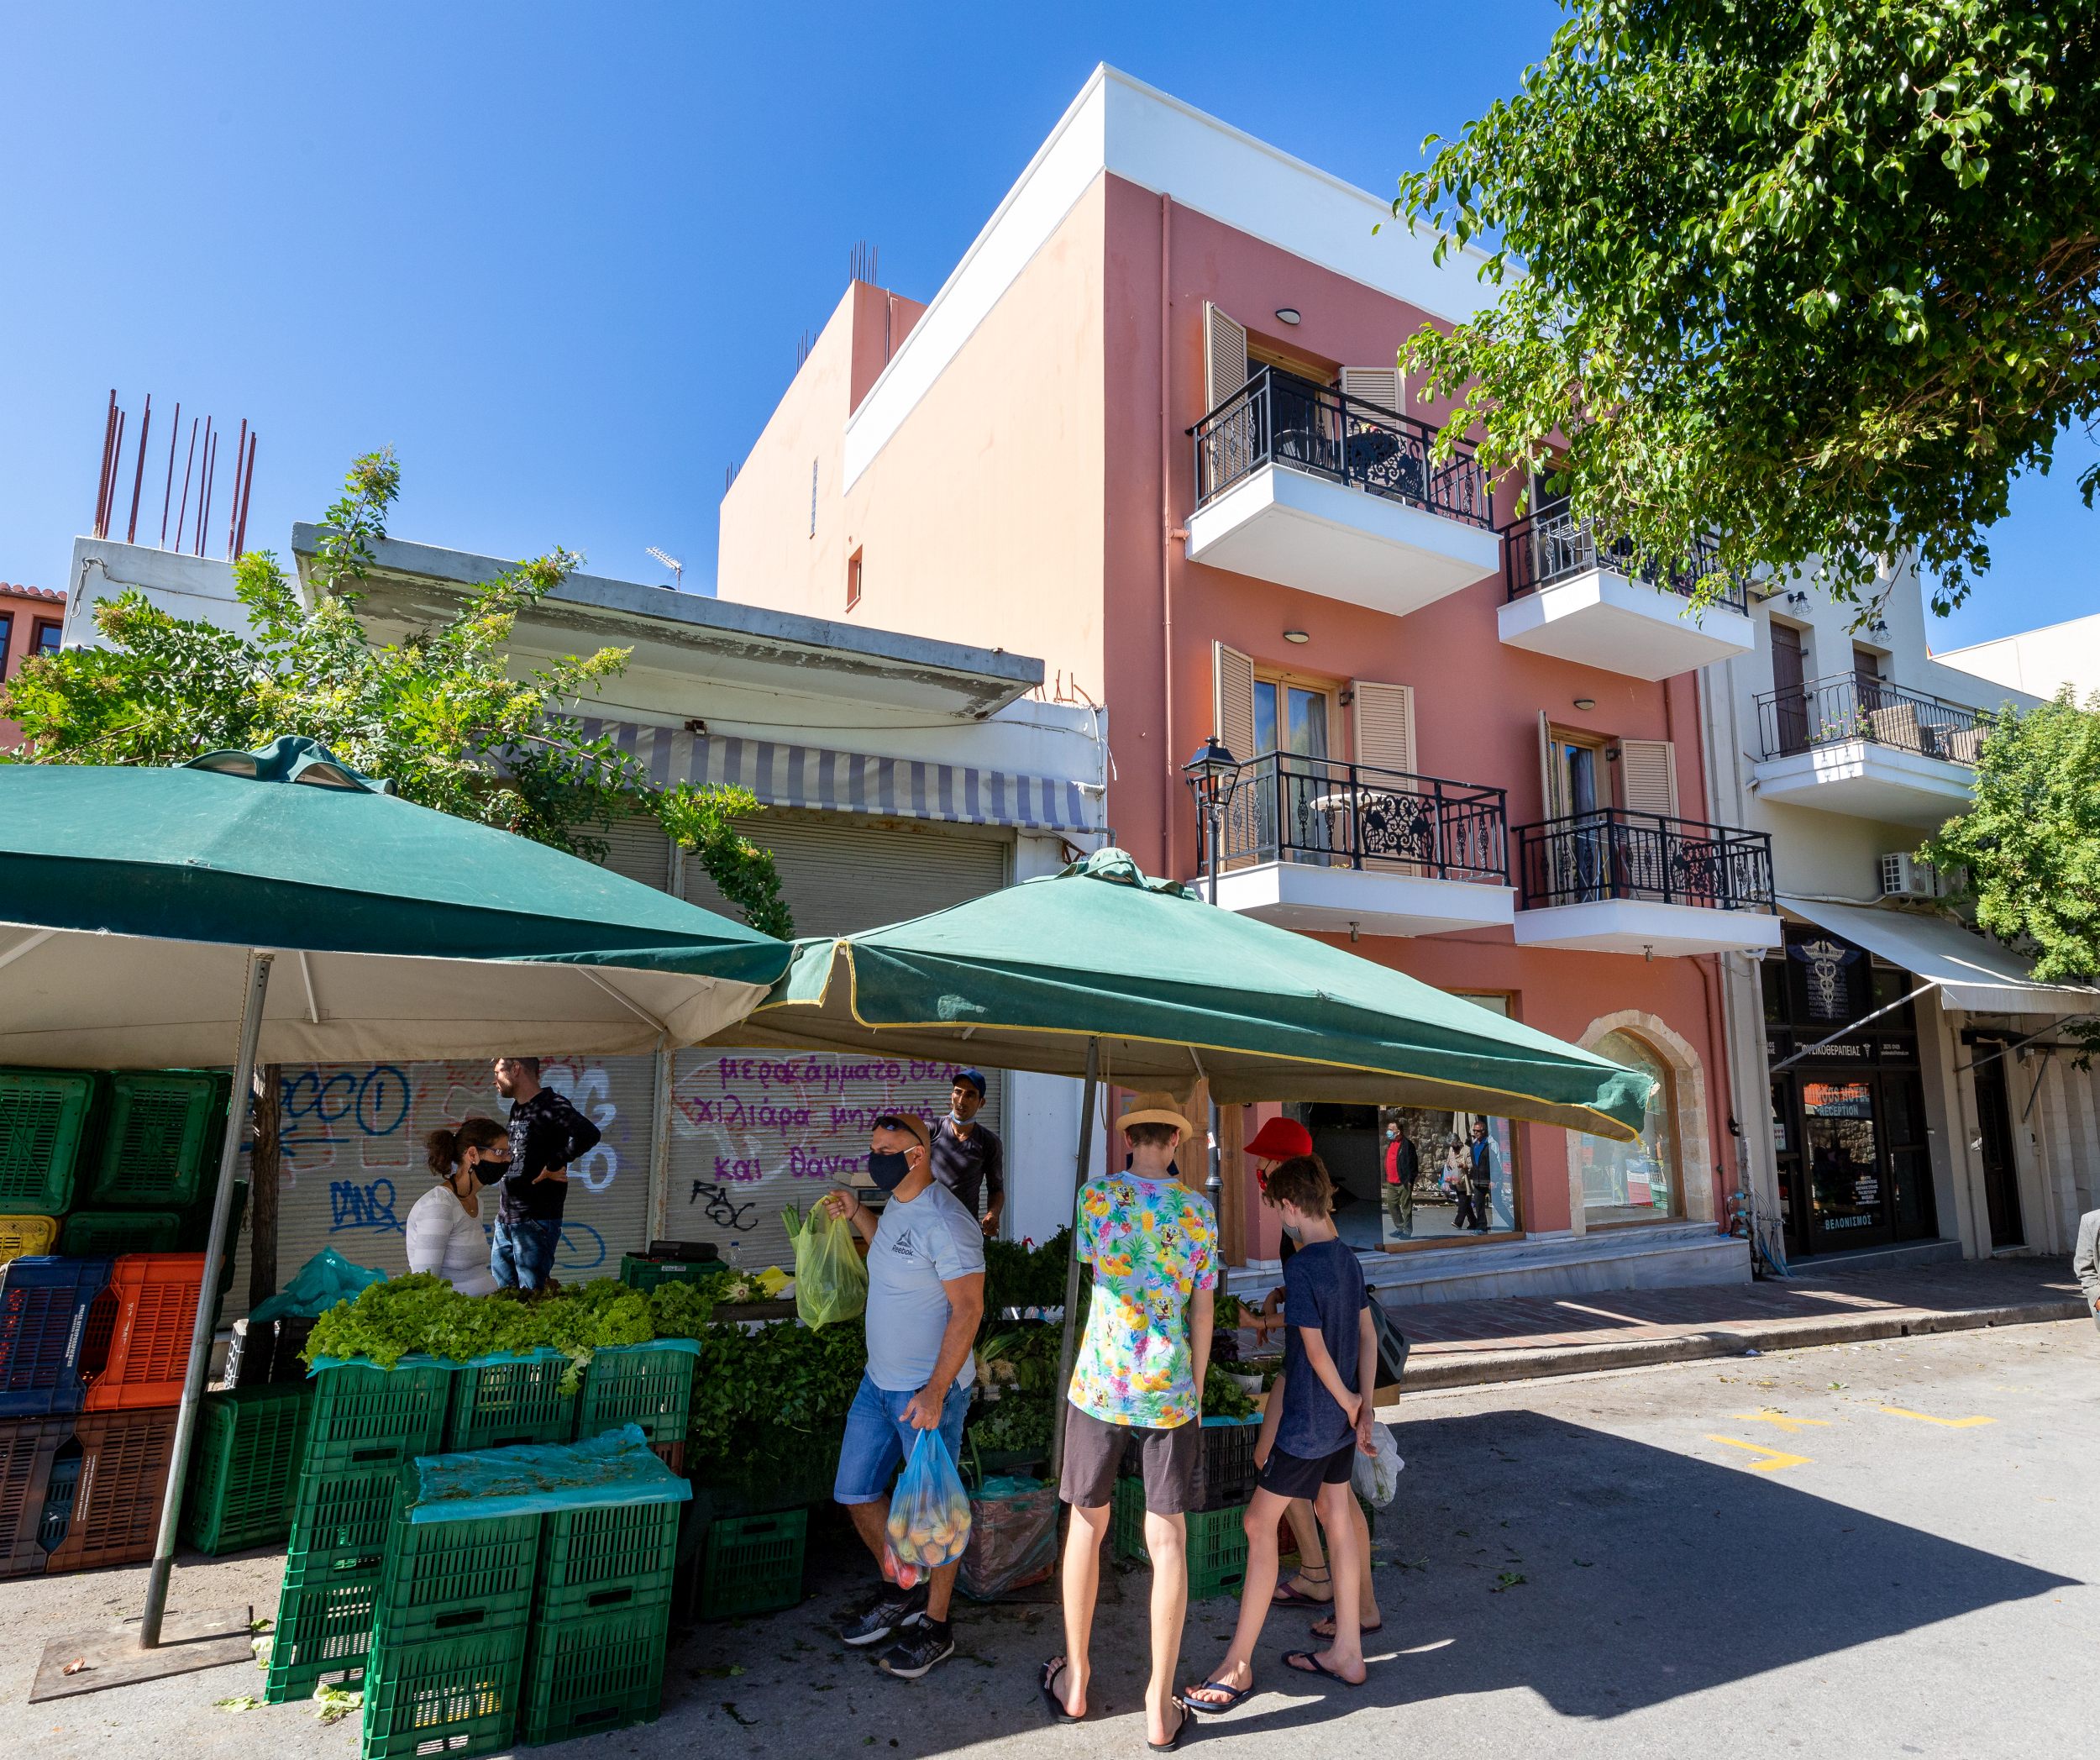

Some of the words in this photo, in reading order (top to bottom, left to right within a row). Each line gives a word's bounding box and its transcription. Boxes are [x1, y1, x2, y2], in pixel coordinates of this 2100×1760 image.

[1819, 1105, 1859, 1116] RECEPTION
[714, 1156, 762, 1181] και
[790, 1146, 870, 1179] θάνατ
[1825, 1215, 1872, 1230] ΒΕΛΟΝΙΣΜΟΣ
[892, 1244, 914, 1257] Reebok
